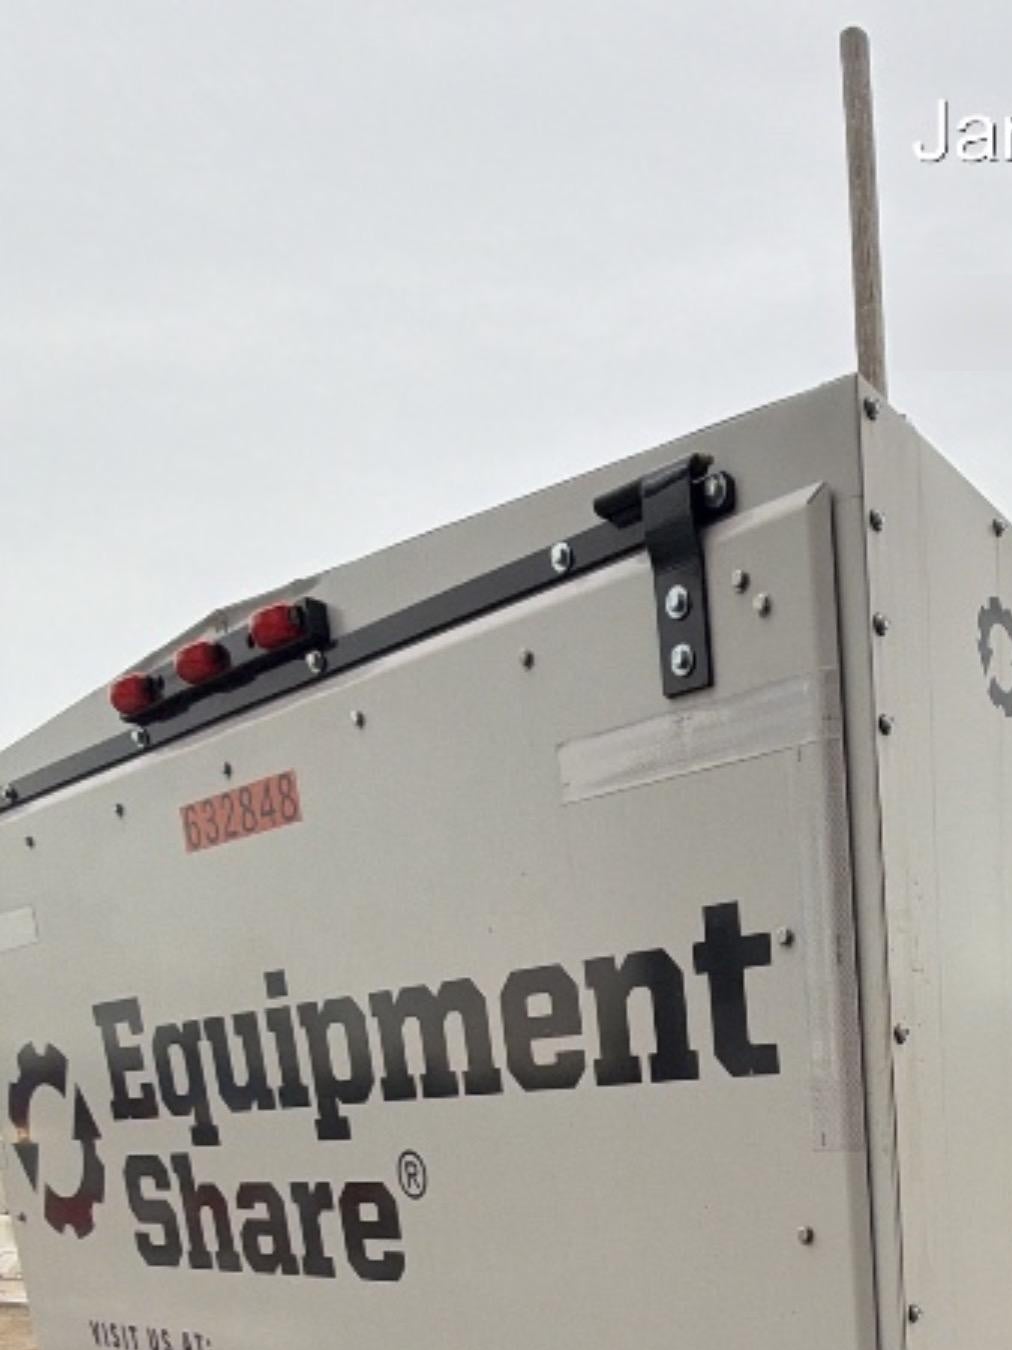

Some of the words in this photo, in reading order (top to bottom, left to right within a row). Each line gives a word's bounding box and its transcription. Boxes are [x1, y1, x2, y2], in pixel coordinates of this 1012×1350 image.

[182, 772, 300, 850] 632848
[92, 901, 781, 1147] Equipment
[89, 1319, 138, 1350] VISIT
